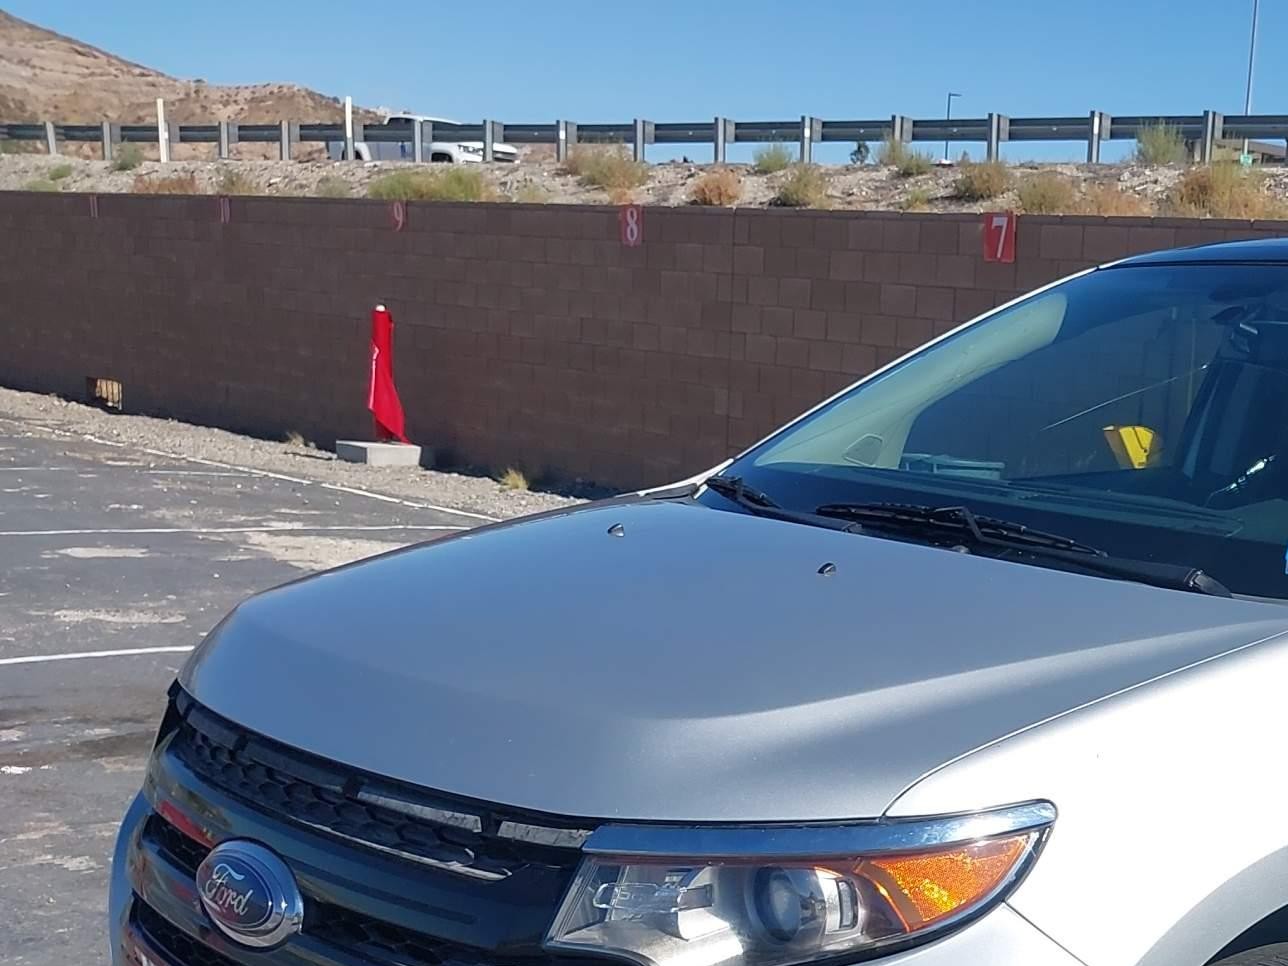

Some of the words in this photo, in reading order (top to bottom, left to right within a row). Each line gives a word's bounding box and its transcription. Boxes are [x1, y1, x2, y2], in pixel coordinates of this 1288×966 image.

[393, 202, 403, 231] 9
[626, 207, 638, 241] 8
[991, 216, 1008, 258] 7
[205, 863, 254, 916] Ford
